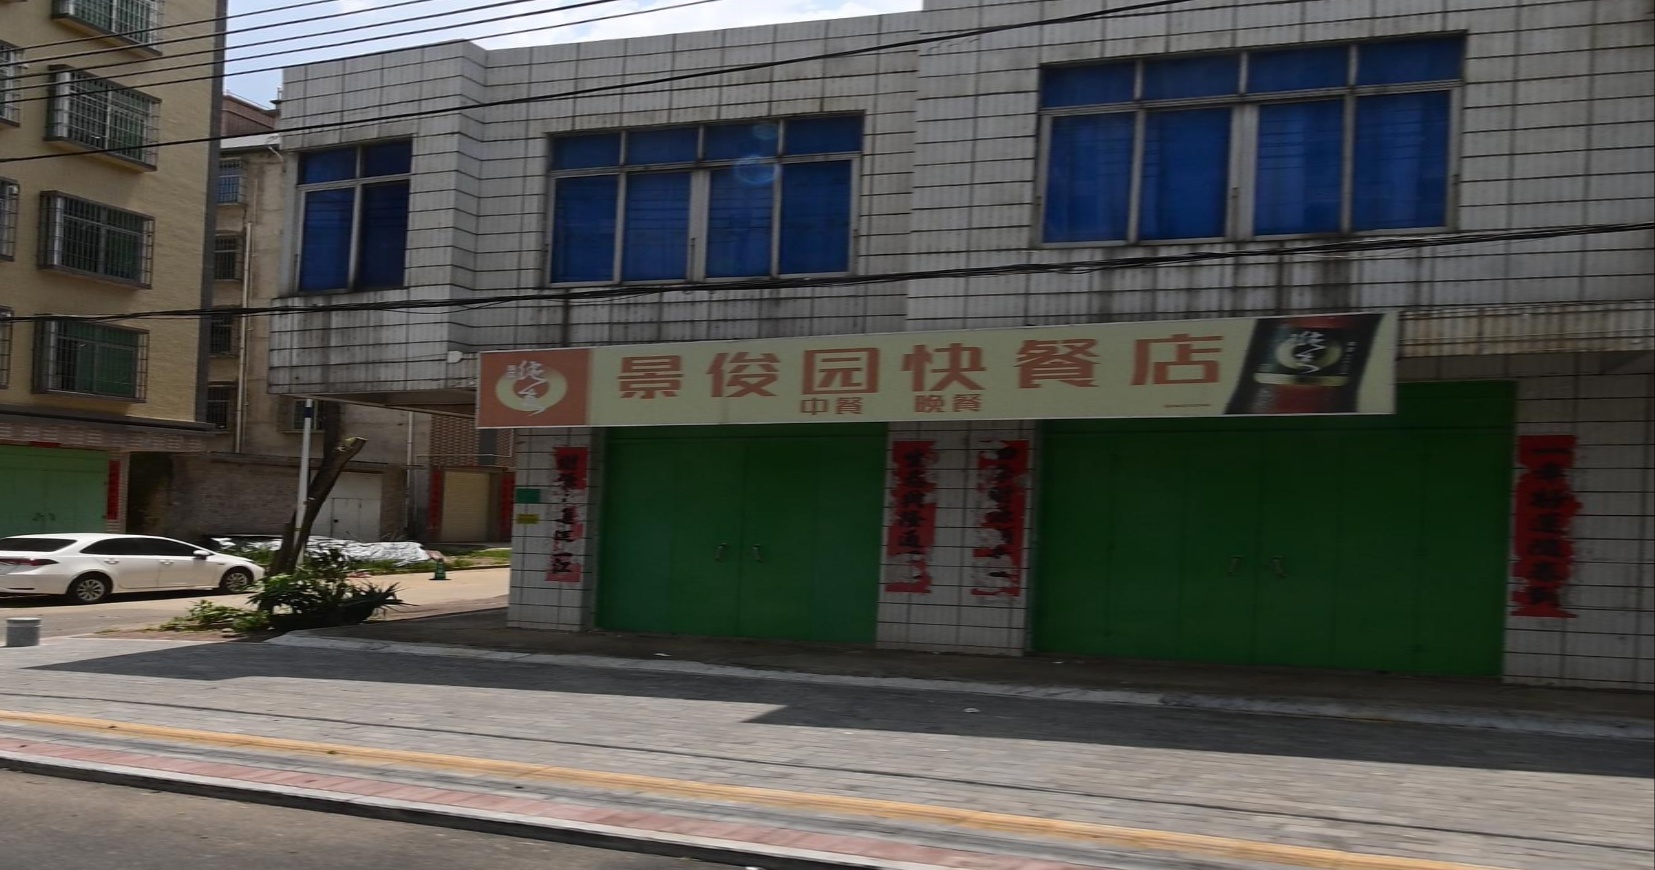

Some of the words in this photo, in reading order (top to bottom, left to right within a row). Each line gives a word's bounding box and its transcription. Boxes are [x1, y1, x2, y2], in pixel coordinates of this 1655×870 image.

[618, 334, 1224, 399] 景俊园快餐店
[800, 396, 862, 415] 中餐
[915, 394, 981, 414] 晚餐
